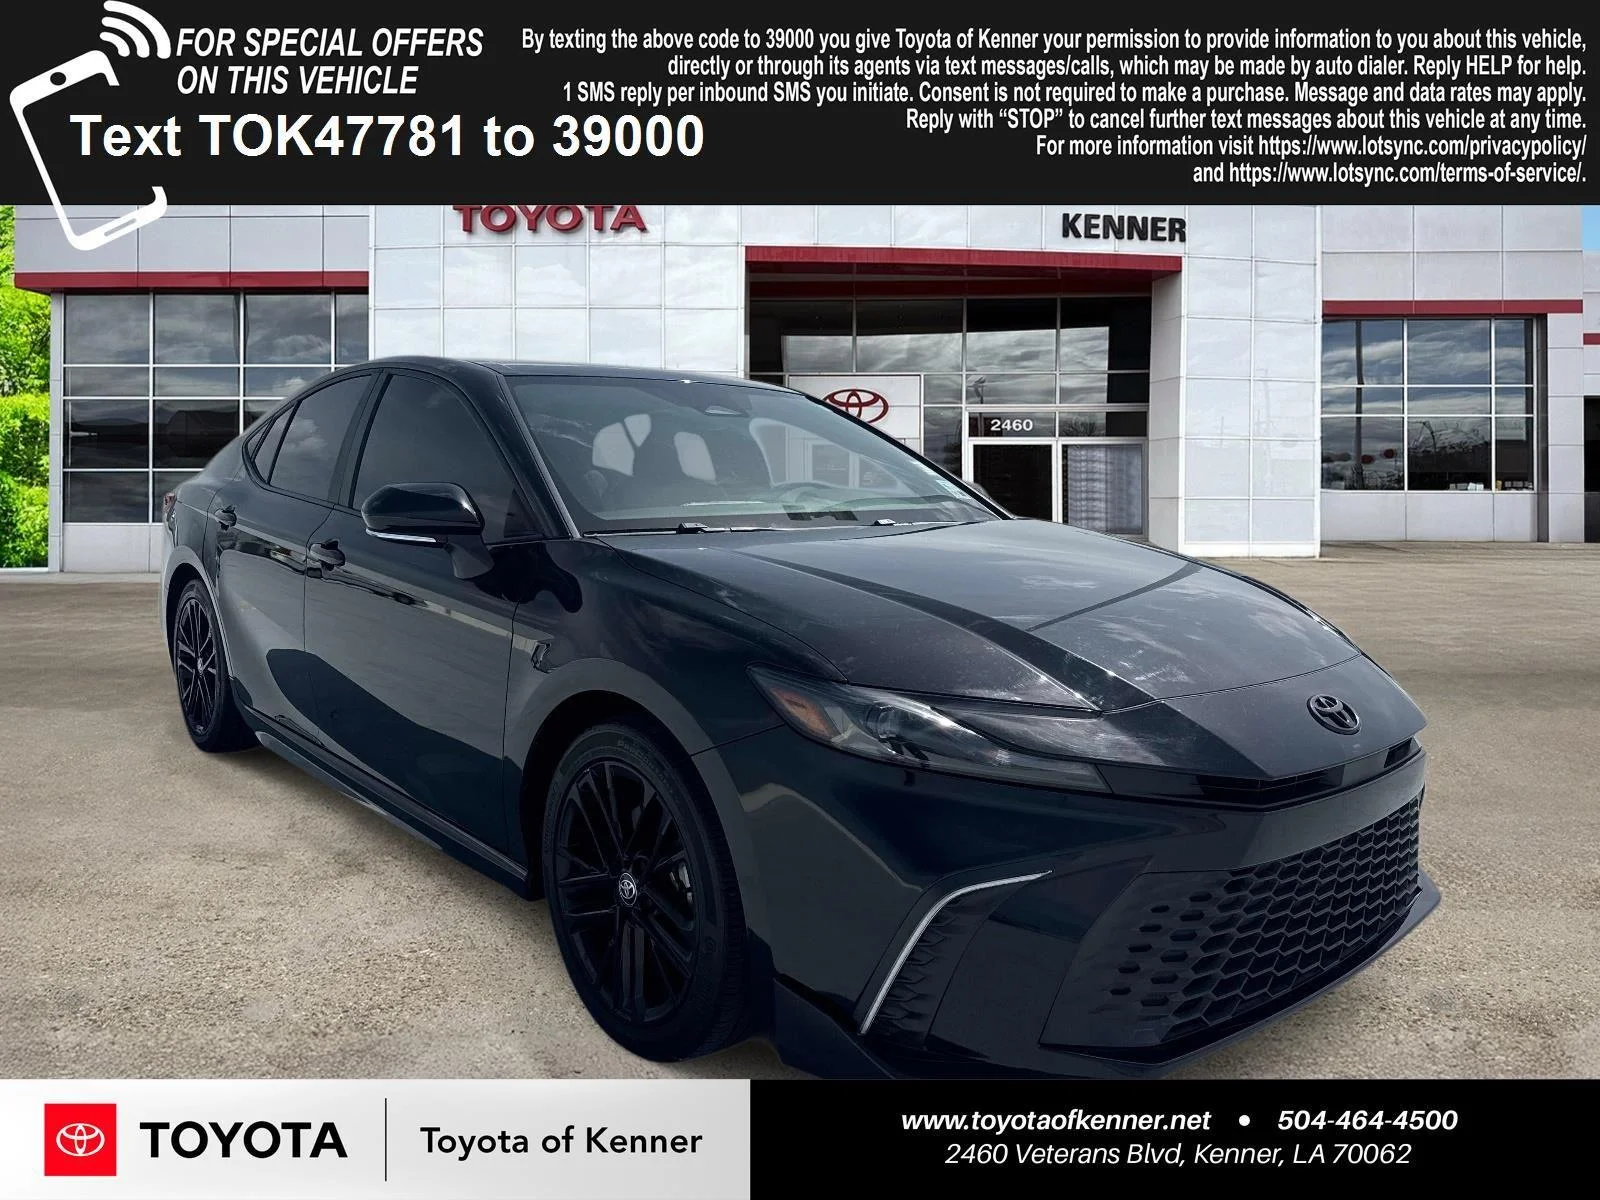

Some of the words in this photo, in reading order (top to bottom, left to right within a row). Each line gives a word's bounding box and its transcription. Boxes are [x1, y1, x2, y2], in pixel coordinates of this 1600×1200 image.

[453, 205, 647, 232] TOYOTA
[1062, 213, 1187, 242] KENNER
[990, 419, 1033, 431] 2460
